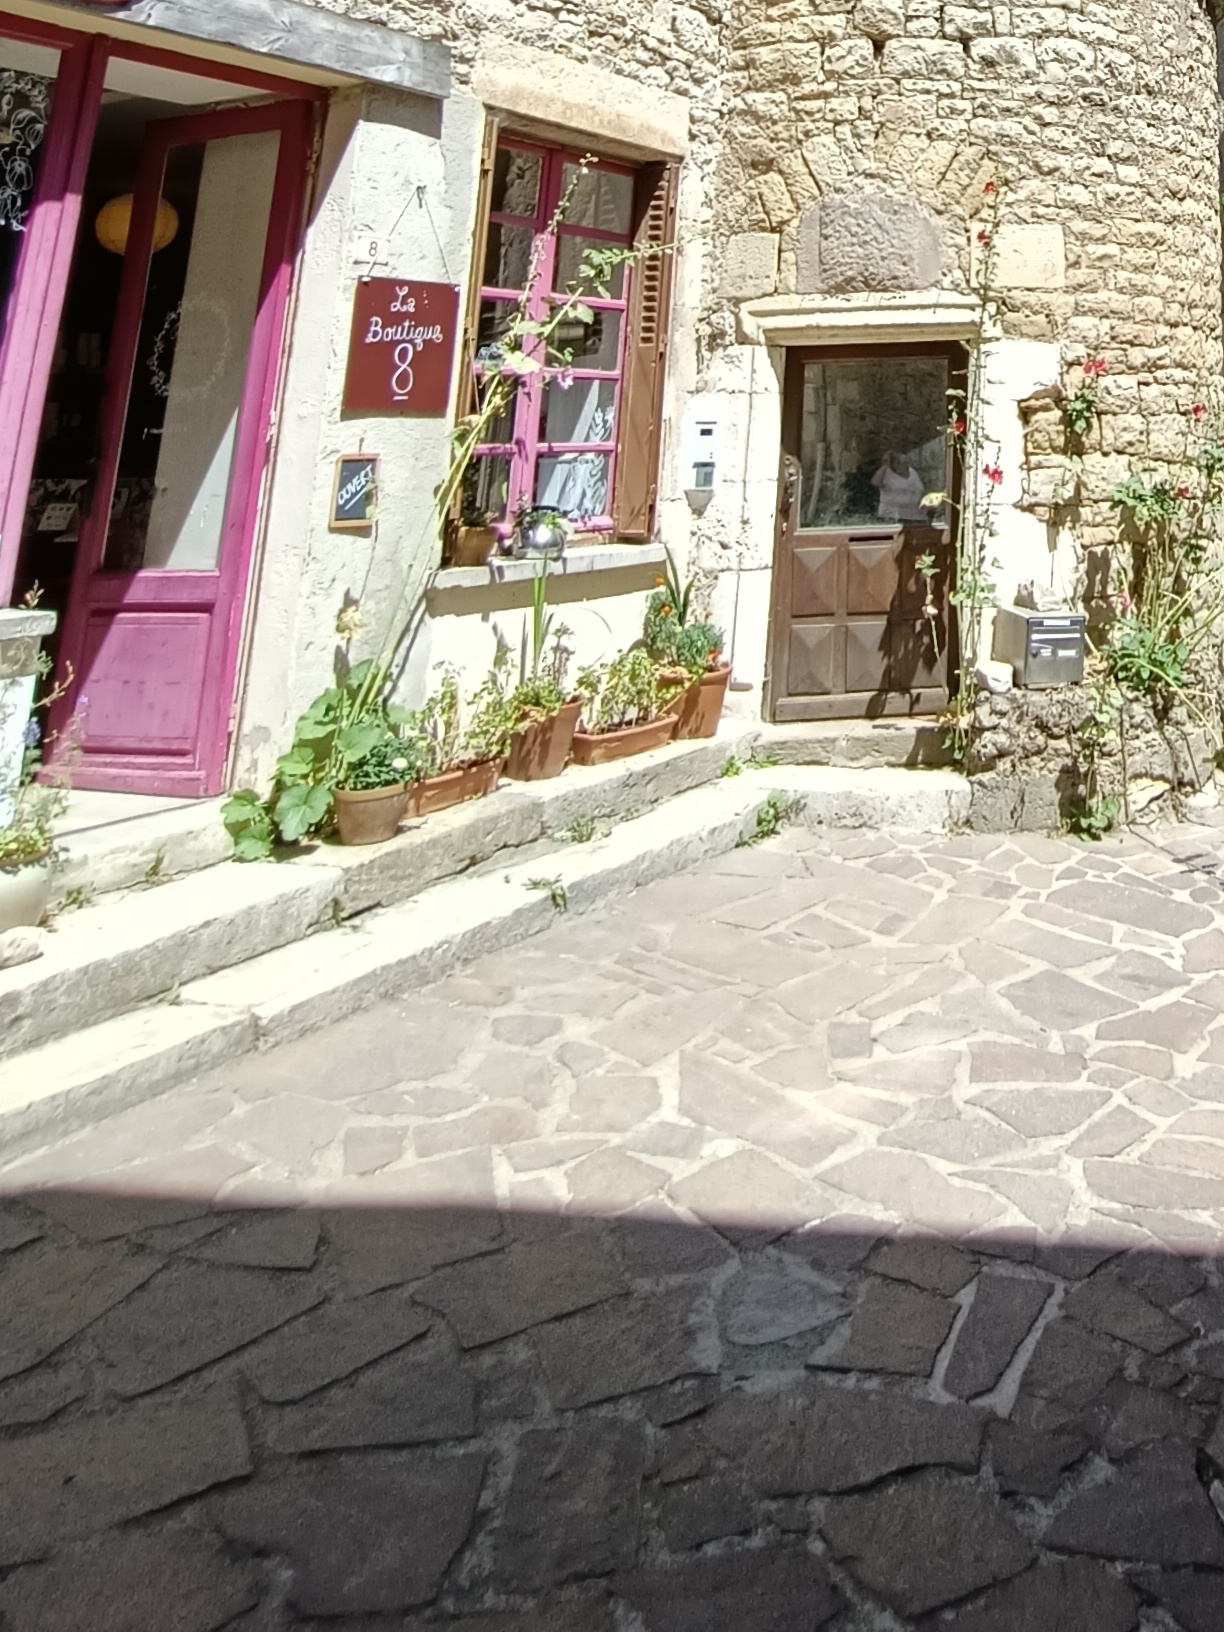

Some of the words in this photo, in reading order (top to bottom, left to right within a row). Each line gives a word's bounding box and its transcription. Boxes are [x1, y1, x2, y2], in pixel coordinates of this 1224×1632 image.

[368, 240, 378, 258] 8
[390, 285, 416, 313] La
[365, 316, 443, 351] Boutique
[392, 343, 413, 394] 8
[338, 464, 373, 506] OUVERT
